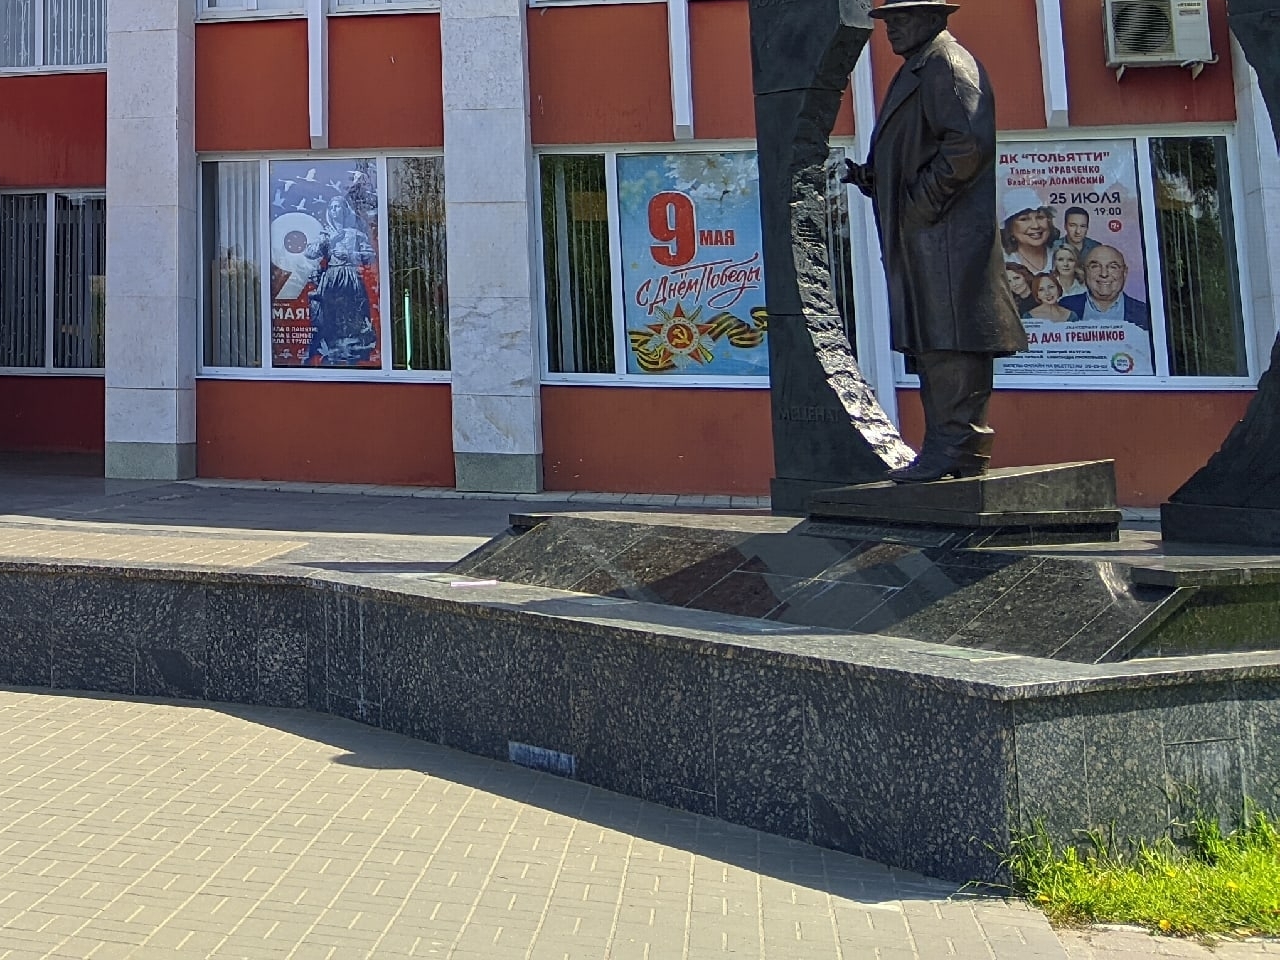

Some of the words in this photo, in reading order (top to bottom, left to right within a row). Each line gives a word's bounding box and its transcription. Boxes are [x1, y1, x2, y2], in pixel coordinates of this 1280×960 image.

[999, 153, 1018, 165] ДК
[1048, 165, 1100, 174] КРАВЧЕНКО
[1049, 174, 1105, 186] ДОЛИНСКИЙ
[1049, 192, 1067, 205] 25
[1071, 191, 1120, 204] ИЮЛЯ
[648, 191, 696, 268] 9
[699, 229, 735, 246] МАЯ
[272, 307, 310, 320] МАЯ!
[1041, 332, 1062, 344] ДЛЯ
[1065, 330, 1125, 343] ГРЕШНИКОВ
